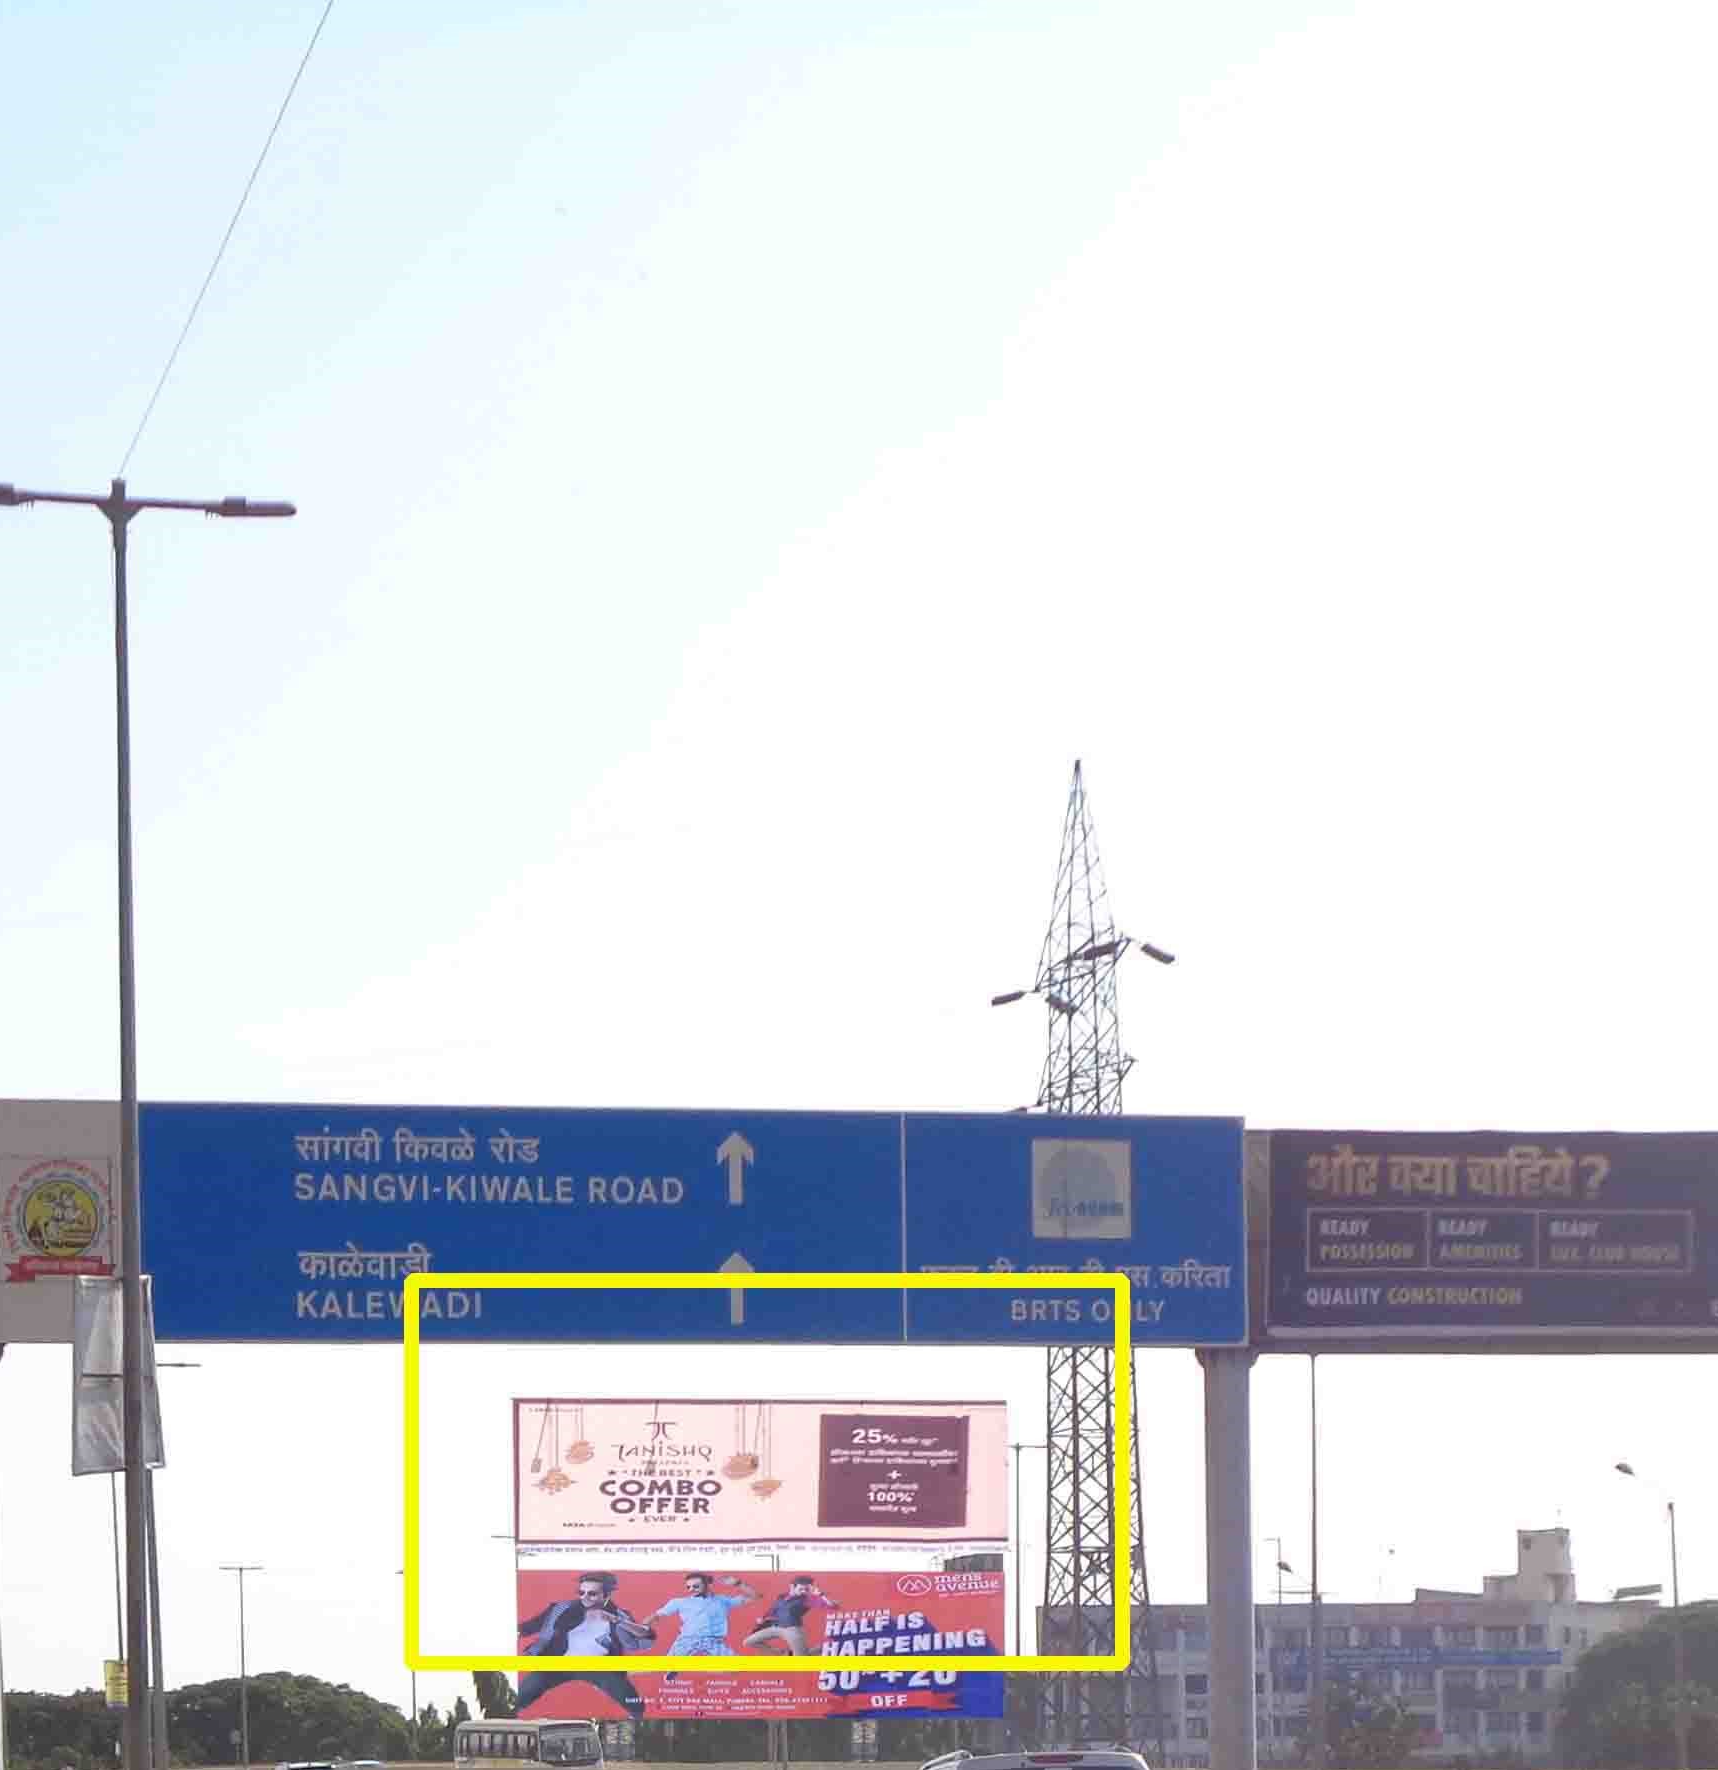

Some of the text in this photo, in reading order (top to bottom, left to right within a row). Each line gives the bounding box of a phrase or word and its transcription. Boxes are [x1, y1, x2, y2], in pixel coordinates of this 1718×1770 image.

[293, 1125, 541, 1164] सांगवी किवळे रोड
[293, 1173, 684, 1204] SANGVI-KIWALE ROAD
[1319, 1219, 1371, 1237] READY
[297, 1241, 433, 1280] काळेवाडी
[1161, 1258, 1232, 1290] करिता
[1306, 1286, 1523, 1306] QUALITY CONSTRUCTION
[1010, 1299, 1165, 1322] BRTS OLY
[599, 1479, 723, 1497] COMBO
[610, 1497, 711, 1515] OFFER
[825, 1610, 925, 1637] HALF IS
[821, 1628, 987, 1657] HAPPENING
[870, 1694, 908, 1708] OFF
